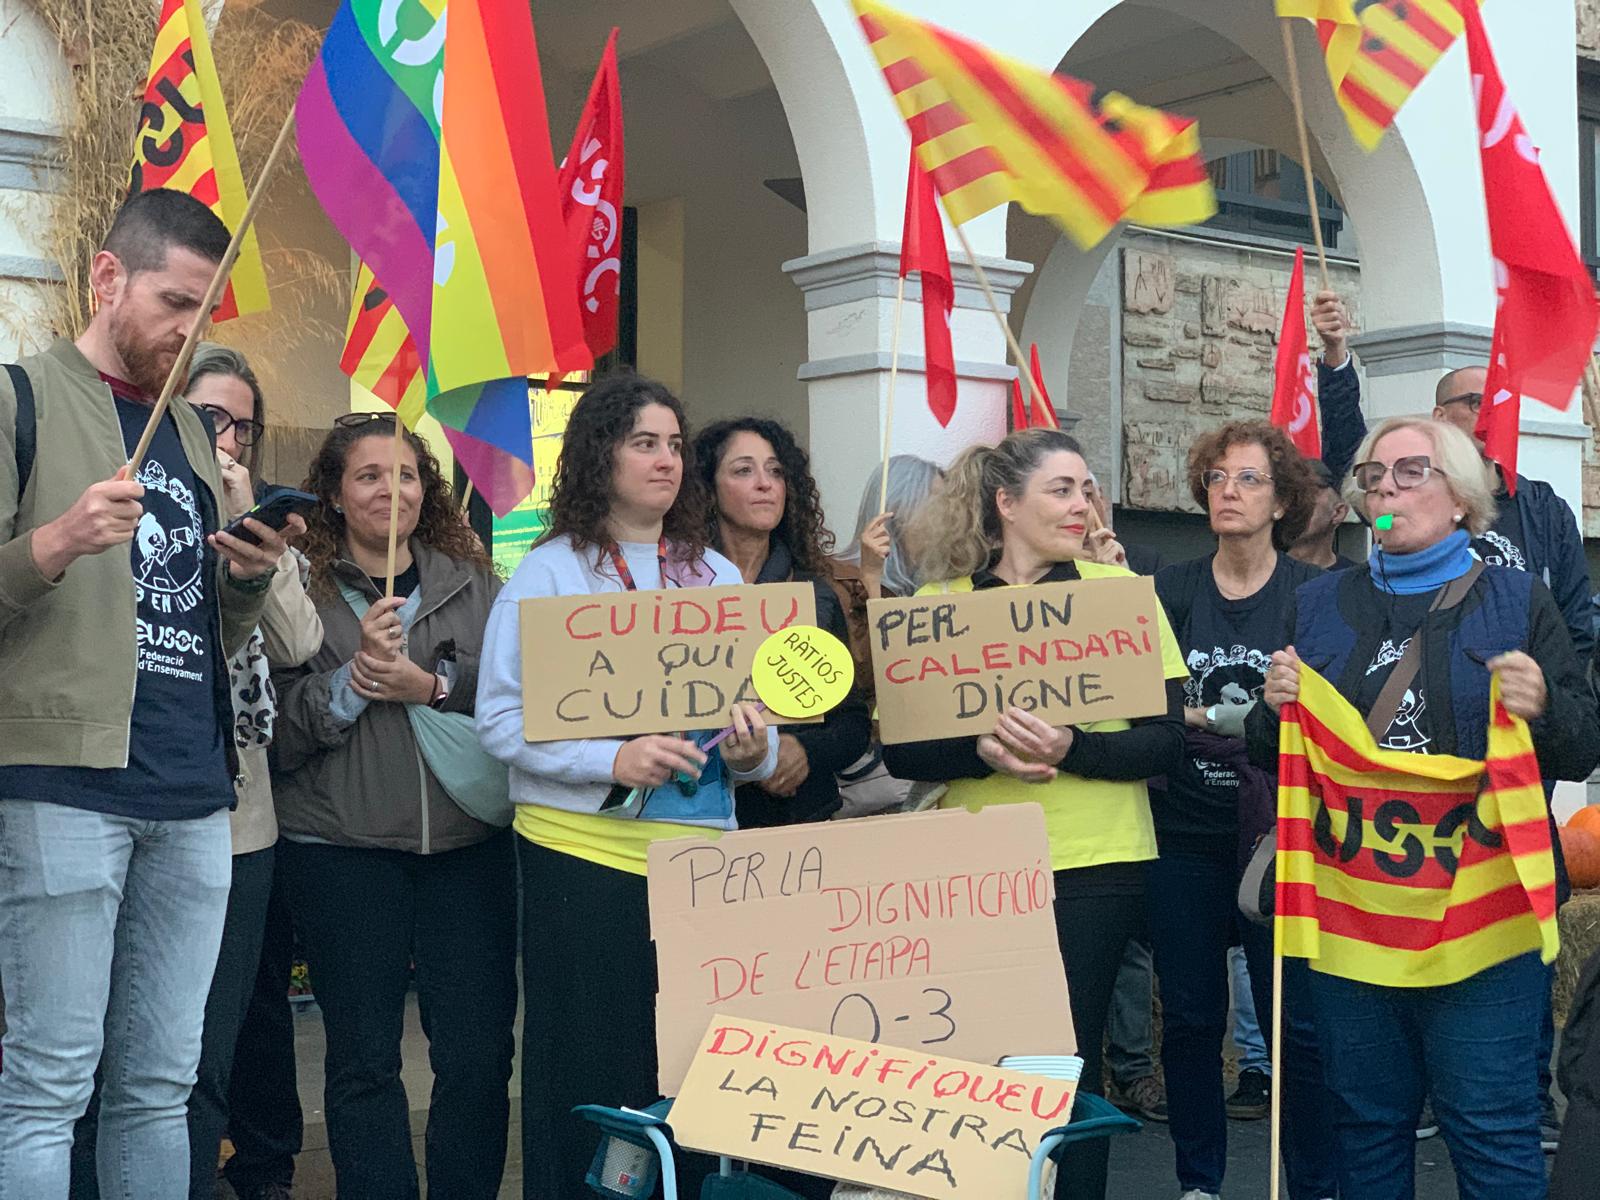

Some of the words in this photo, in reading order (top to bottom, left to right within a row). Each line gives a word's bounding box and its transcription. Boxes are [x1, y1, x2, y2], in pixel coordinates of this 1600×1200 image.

[151, 592, 172, 613] EN
[876, 603, 970, 651] PER
[1010, 593, 1074, 633] UN
[138, 660, 203, 683] d'Ensenyament
[139, 647, 185, 667] Federació
[589, 650, 615, 677] A
[767, 654, 823, 709] JUSTES
[669, 846, 764, 908] PER
[780, 846, 823, 897] LA
[700, 951, 770, 1005] DE
[794, 935, 931, 990] L'ETAPA
[830, 987, 956, 1044] 0-3
[718, 1069, 779, 1101] LA
[811, 1086, 1033, 1160] NOSTRA
